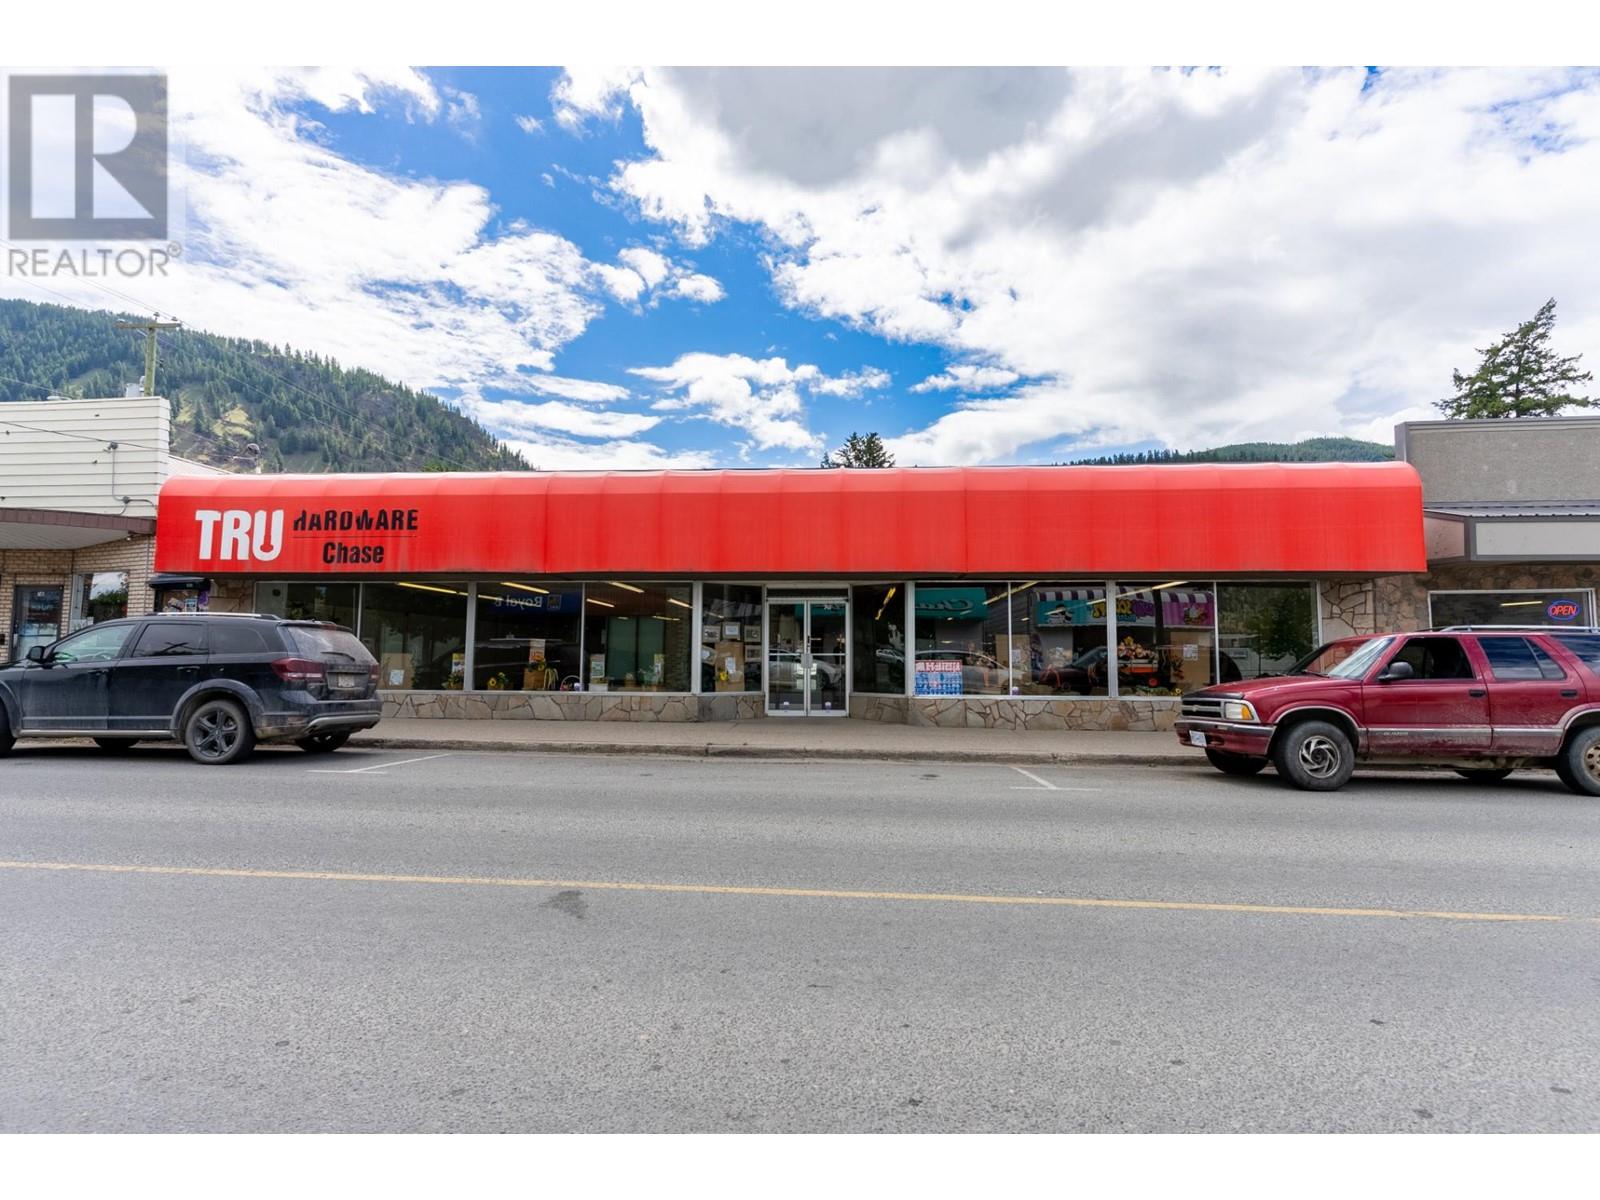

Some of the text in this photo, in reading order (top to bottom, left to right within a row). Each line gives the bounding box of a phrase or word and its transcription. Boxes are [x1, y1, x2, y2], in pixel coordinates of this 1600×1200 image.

[195, 509, 417, 561] TRU HARDWARE
[323, 542, 384, 564] Chase
[1551, 604, 1577, 617] OPEN
